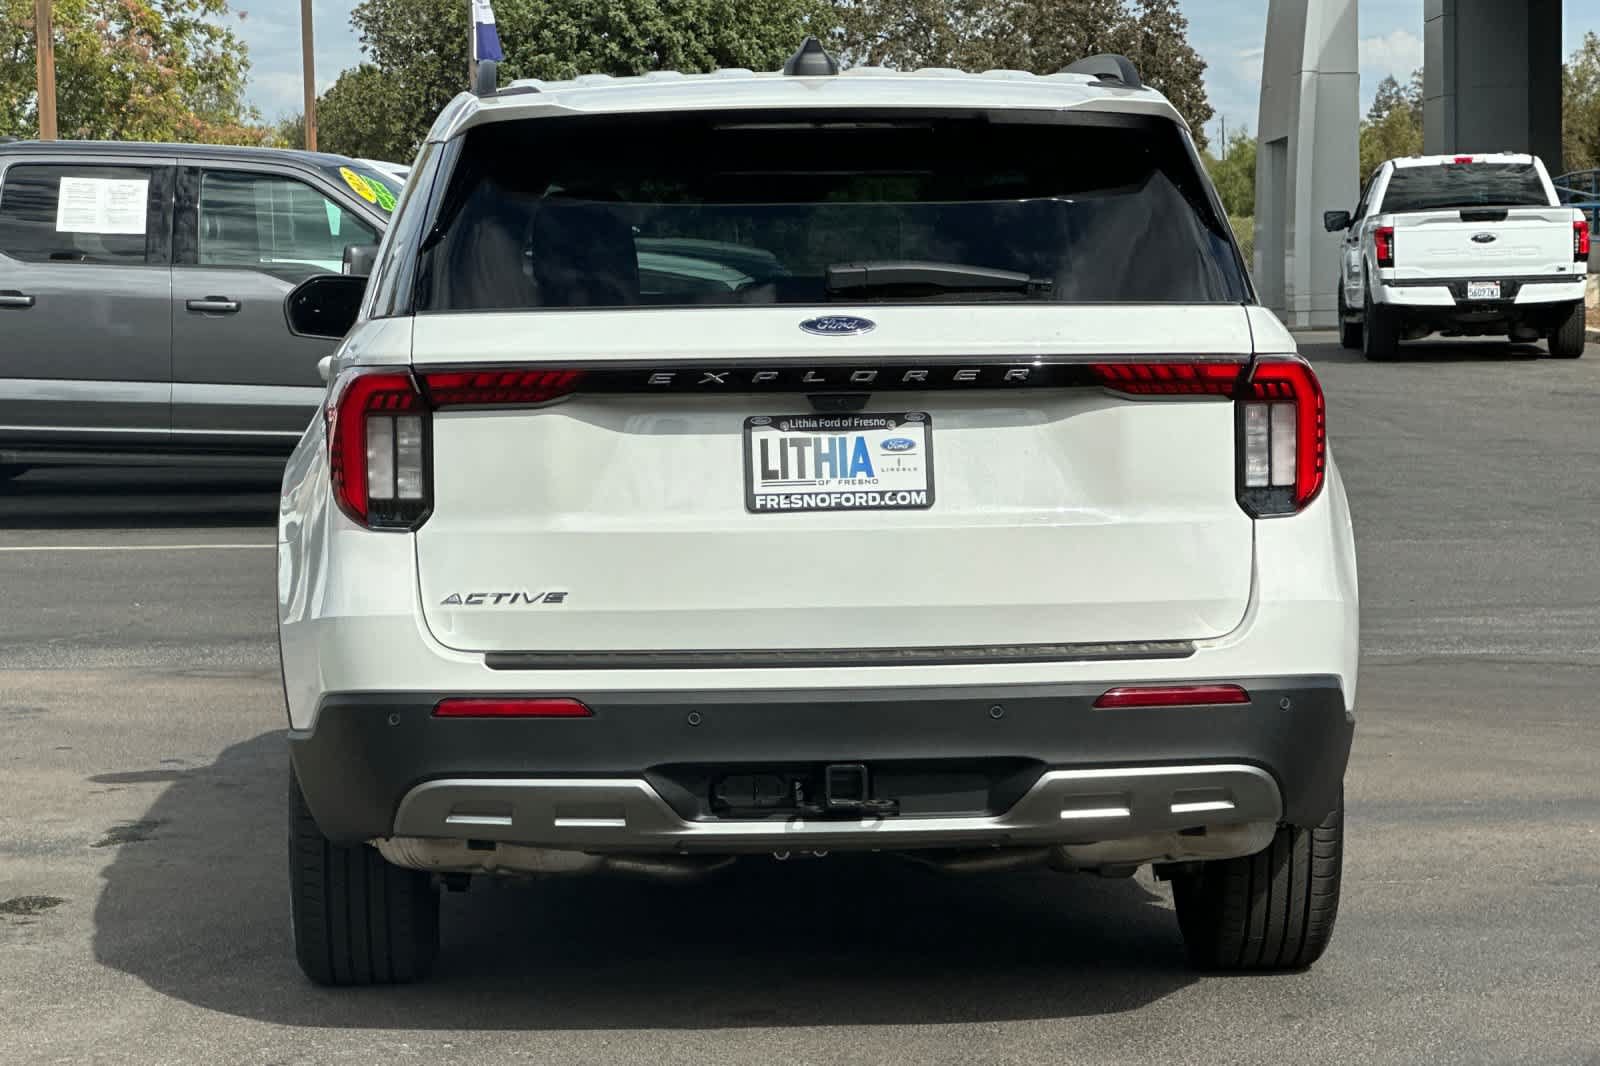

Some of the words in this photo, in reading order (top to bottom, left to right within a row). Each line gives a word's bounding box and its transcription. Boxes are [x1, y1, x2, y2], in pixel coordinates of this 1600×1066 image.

[648, 368, 1030, 385] EXPLORER
[790, 418, 819, 428] Lithia
[819, 418, 841, 428] Ford
[841, 418, 852, 427] of
[854, 417, 886, 427] Fresno
[759, 436, 875, 481] LITHIA
[817, 479, 831, 487] OF
[838, 478, 879, 487] FRESNO
[755, 491, 927, 509] FRESNOFORD.COM
[440, 592, 569, 605] ACTIVE
